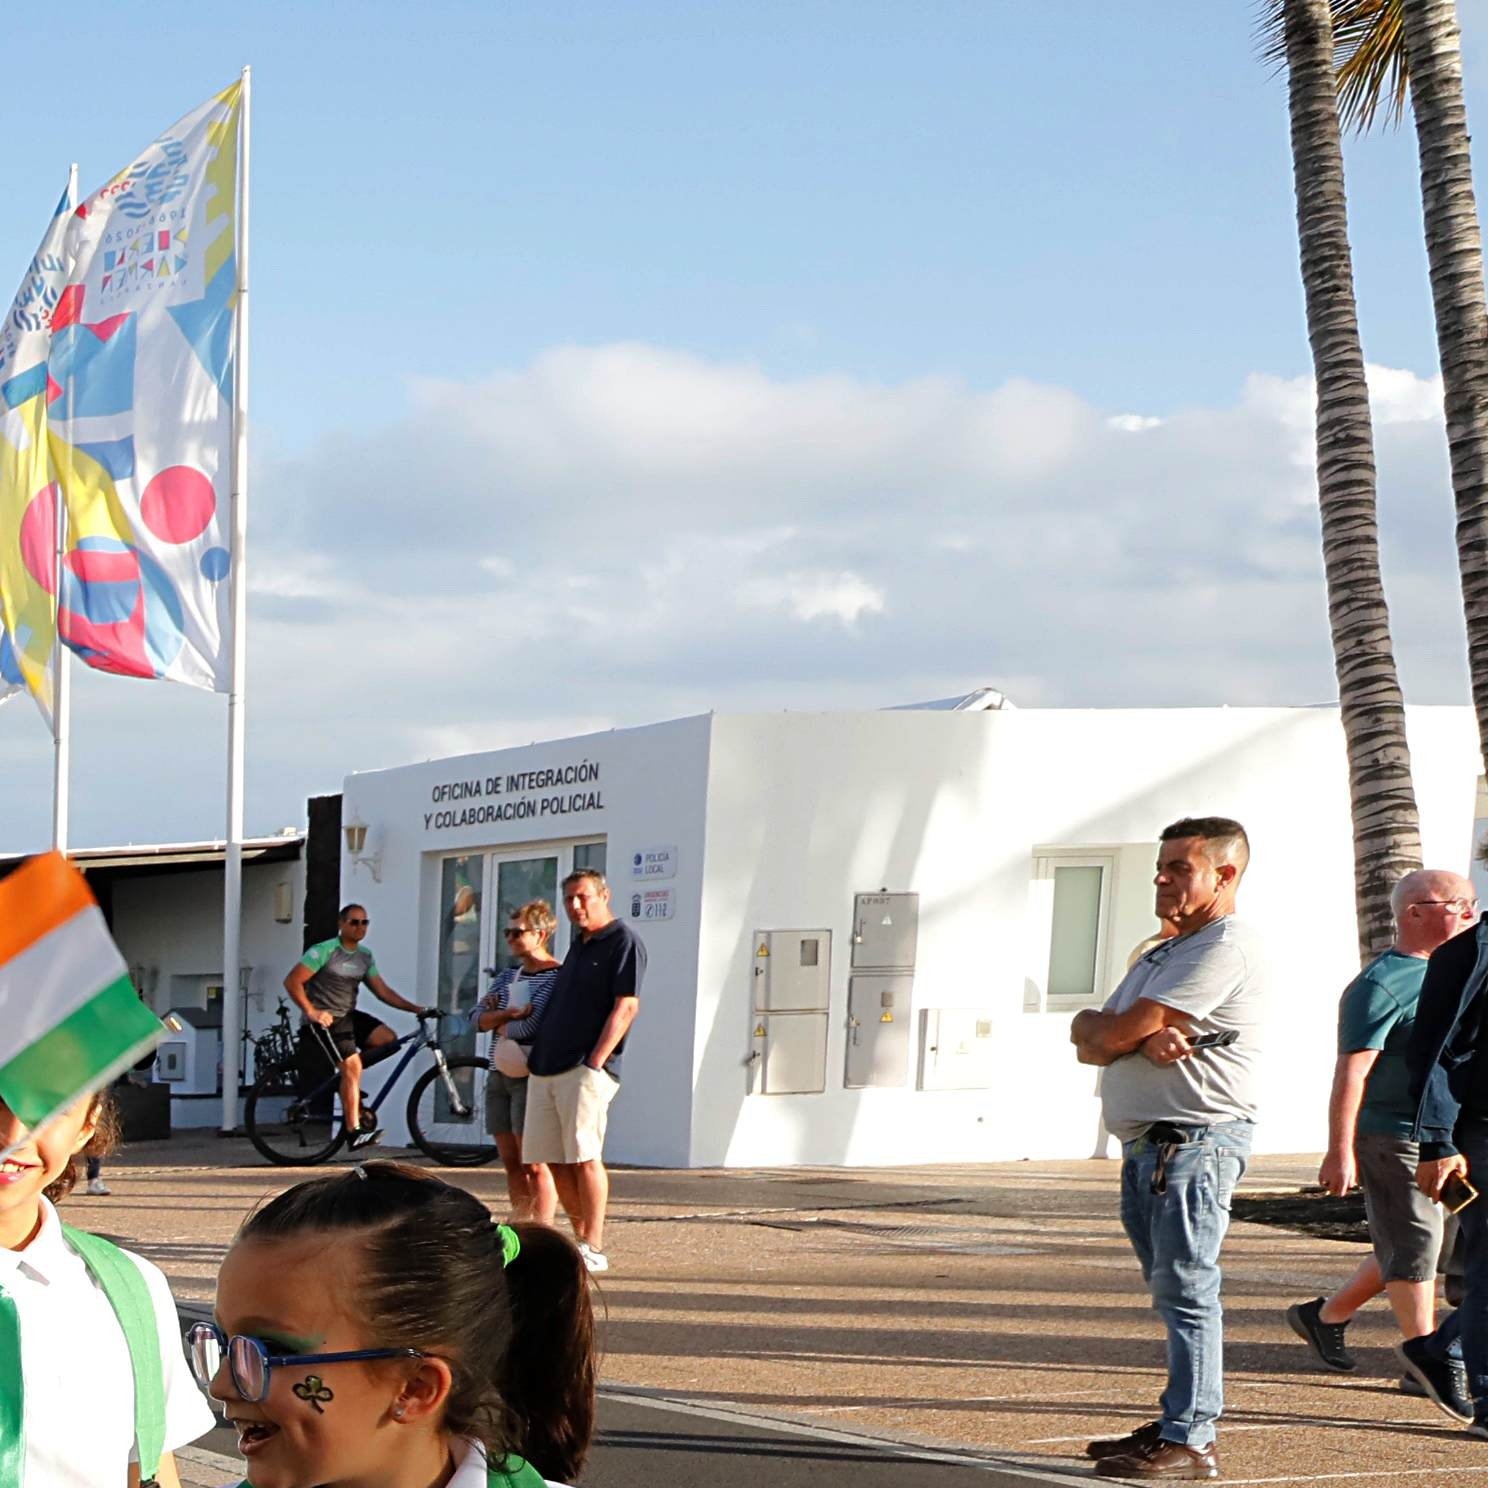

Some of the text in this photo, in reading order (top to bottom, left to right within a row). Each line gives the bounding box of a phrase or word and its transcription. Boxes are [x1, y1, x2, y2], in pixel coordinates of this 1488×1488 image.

[432, 759, 600, 803] OFICINA DE INTEGRACIÓN
[424, 791, 605, 830] Y COLABORACIÓN POLICIAL
